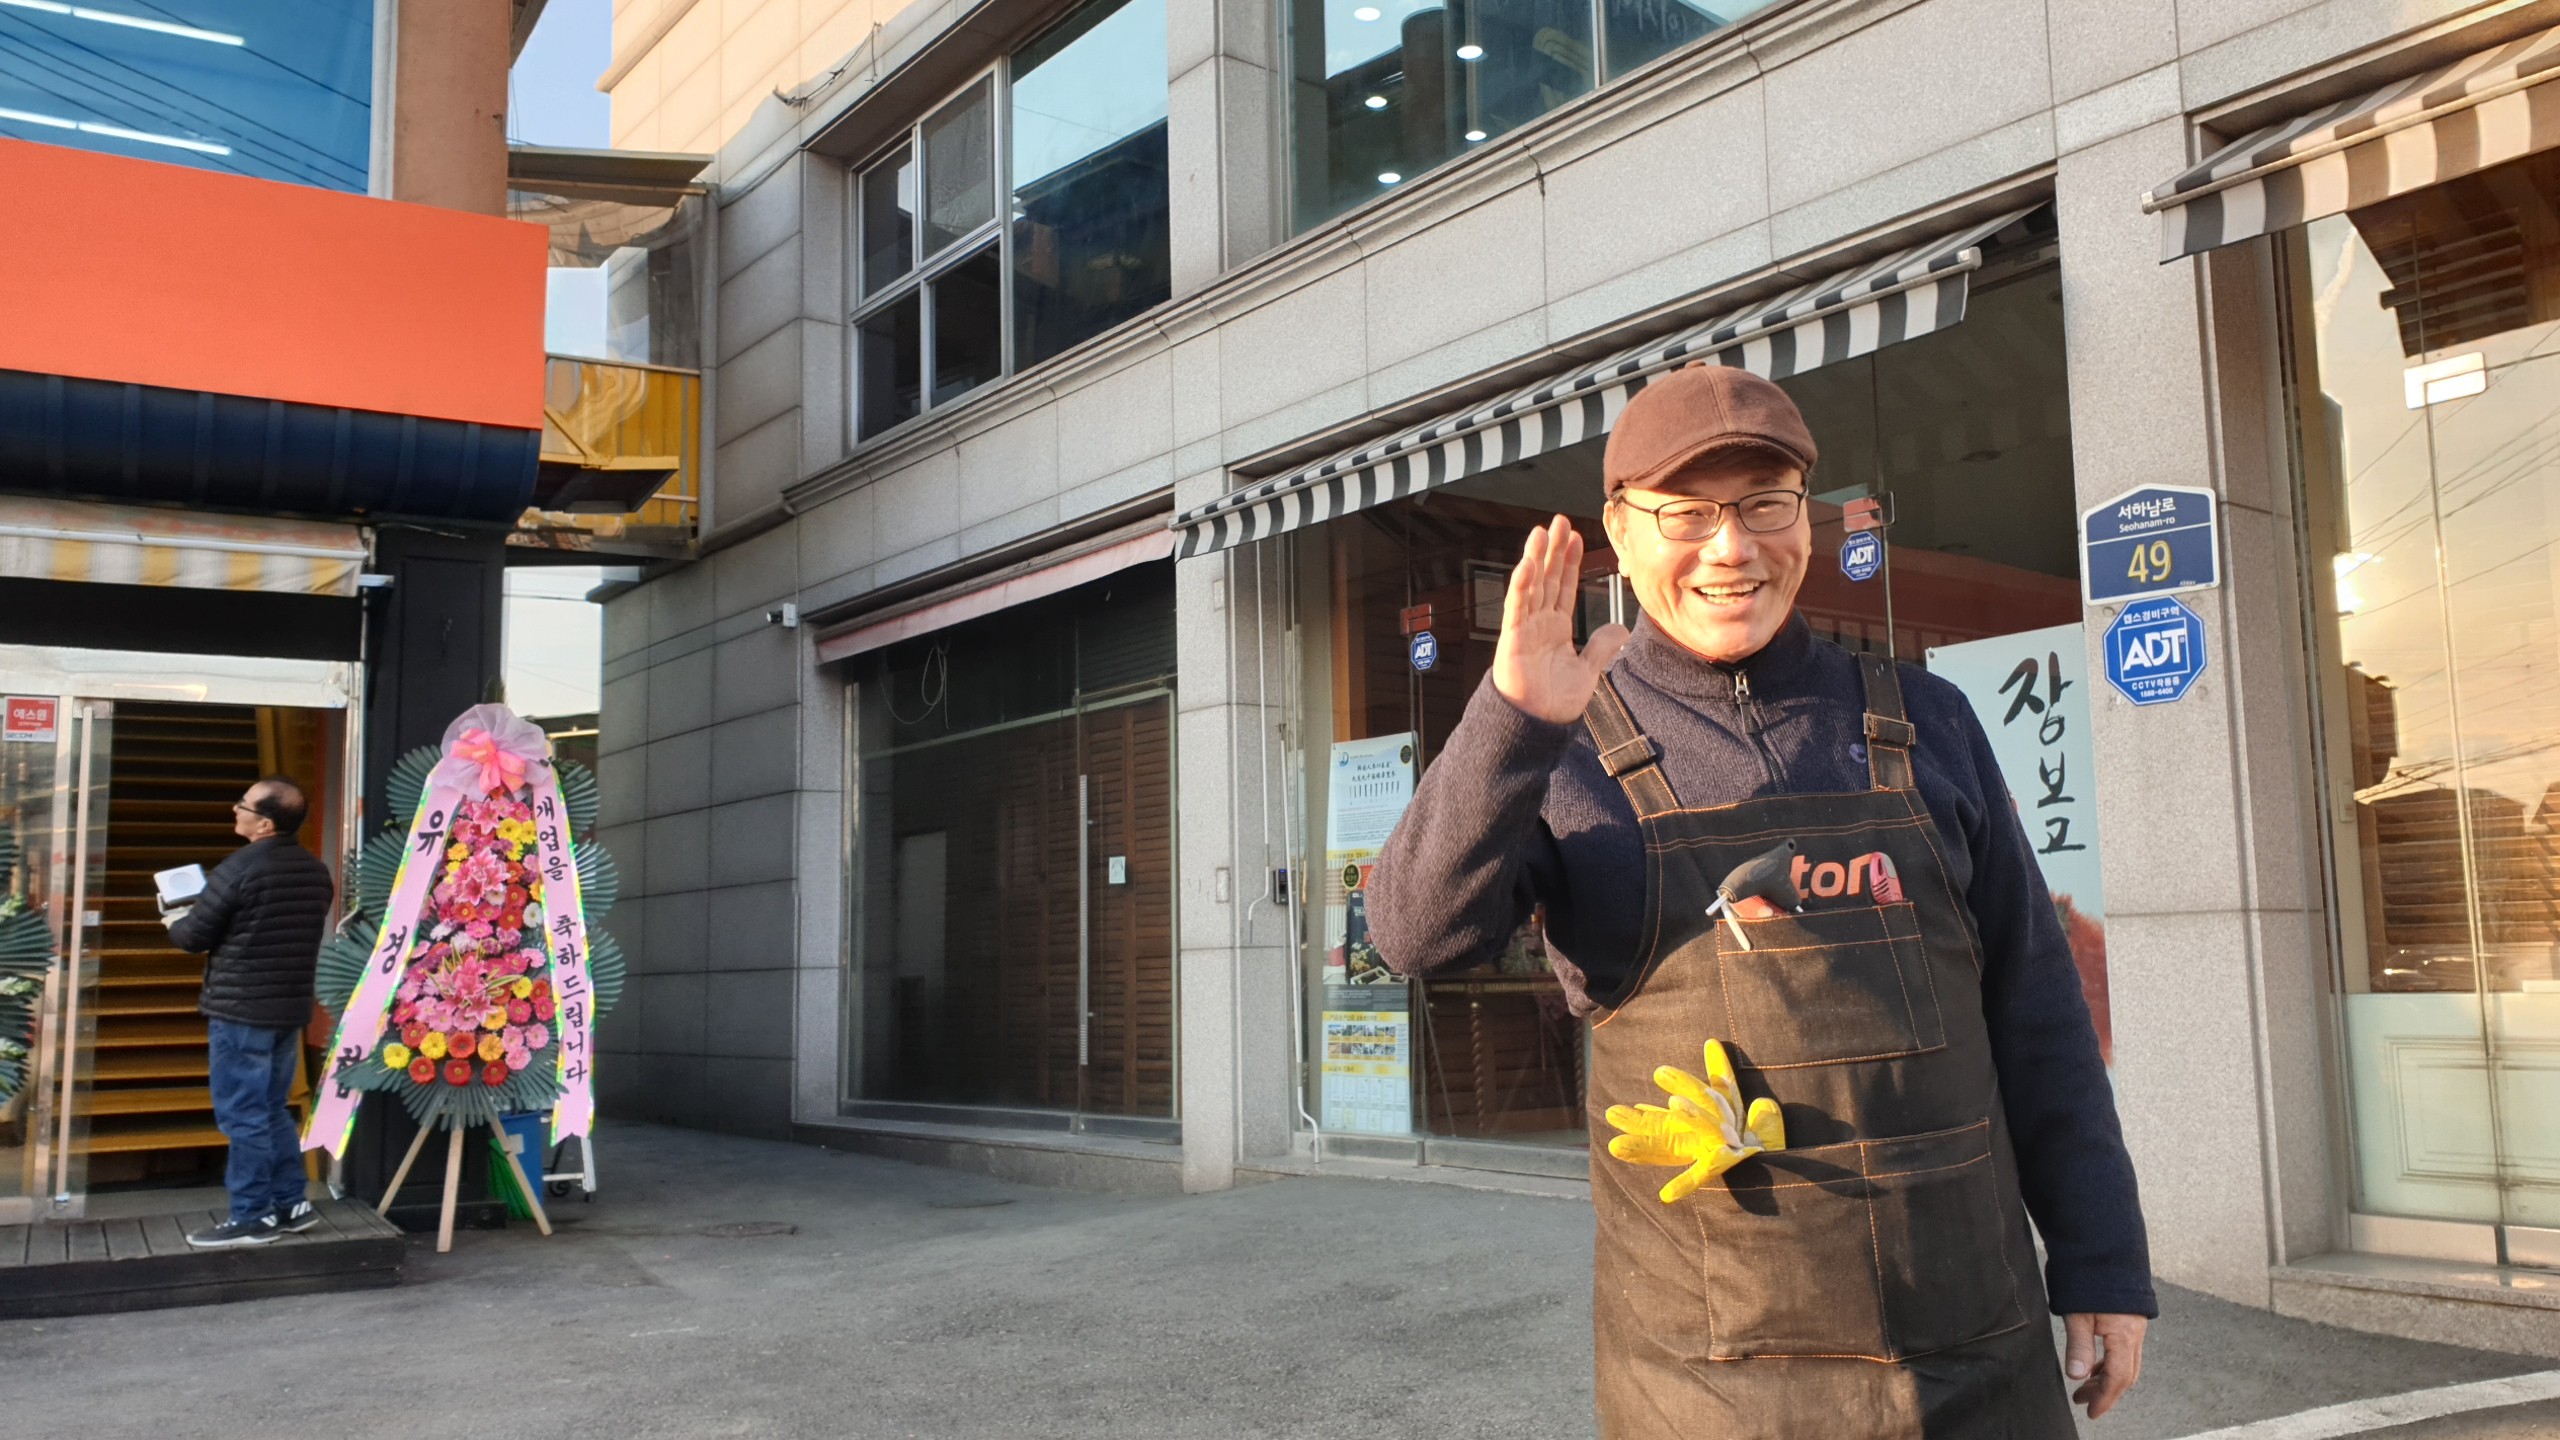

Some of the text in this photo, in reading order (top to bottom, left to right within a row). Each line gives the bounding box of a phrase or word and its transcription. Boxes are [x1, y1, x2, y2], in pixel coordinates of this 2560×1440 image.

[2118, 496, 2177, 520] 서하남로
[2119, 516, 2176, 533] Seohanam-ro
[1847, 545, 1875, 567] ADT
[2127, 540, 2173, 584] 49
[1415, 643, 1433, 659] ADT
[2123, 628, 2186, 672] ADT
[1998, 651, 2087, 855] 장보고
[536, 796, 588, 1085] 개업을 축하드립니다
